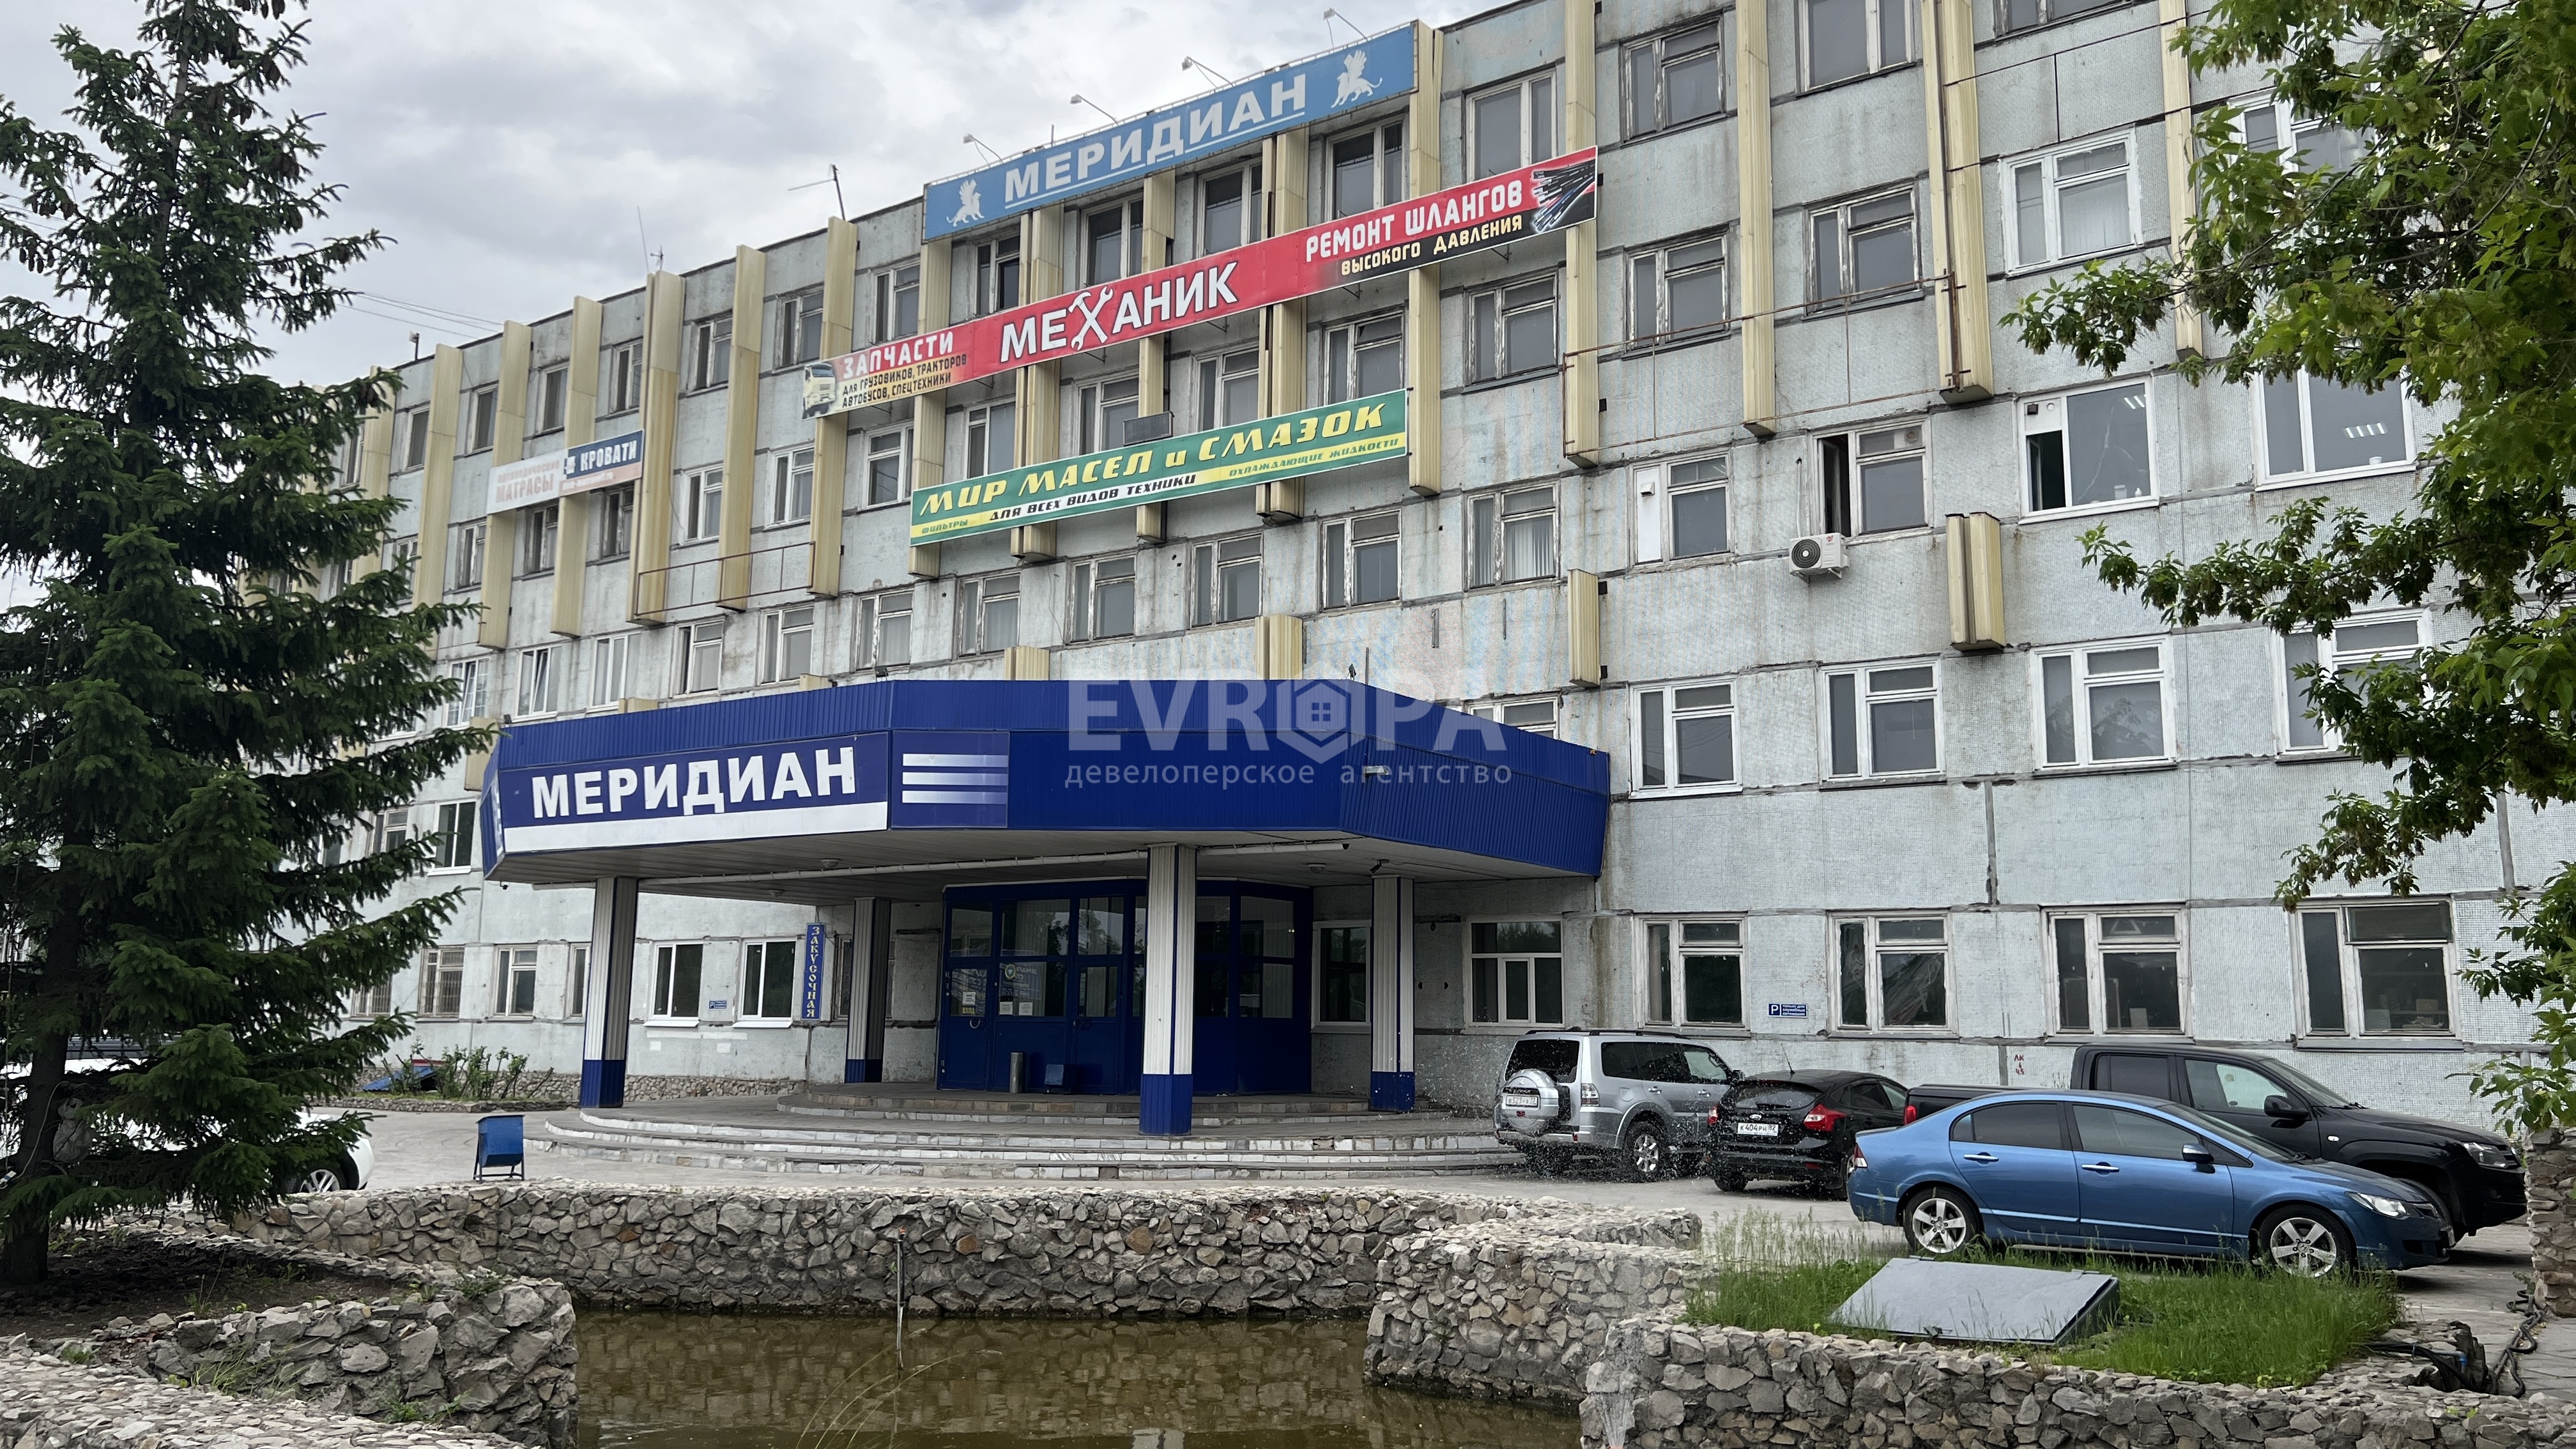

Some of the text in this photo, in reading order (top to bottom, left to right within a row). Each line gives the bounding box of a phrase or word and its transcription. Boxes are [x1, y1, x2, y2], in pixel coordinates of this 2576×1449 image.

[1005, 73, 1306, 203] МЕРИДИАН
[1307, 180, 1522, 262] РЕМОНТ ШЛАНГОВ
[1341, 214, 1522, 275] ВЫСОКОГО ДАВЛЕНИЯ
[1000, 261, 1238, 362] МЕХАНИК
[843, 331, 953, 379] ЗАПЧАСТИ
[843, 354, 967, 396] ДЛЯ ГРУЗОВИКОВ, ТРАКТОРОВ
[842, 372, 951, 408] АВТОБУСОВ, СПЕЦТЕХНИКИ
[496, 473, 554, 503] МАТРАСЫ
[580, 440, 637, 471] КРОВАТИ
[919, 480, 1007, 516] МИР
[1018, 450, 1154, 496] МАСЕЛ
[1199, 402, 1387, 461] СМАЗОК
[921, 438, 1399, 534] ФИЛЬТРЫ ДЛЯ ВСЕХ ВИДОВ ТЕХНИКИ ОХЛАЖДАЮЩИЕ ЖИДКОСТИ
[532, 746, 856, 818] МЕРИДИАН
[806, 926, 820, 1018] ЗАКУСОЧНАЯ
[1771, 1004, 1779, 1015] P
